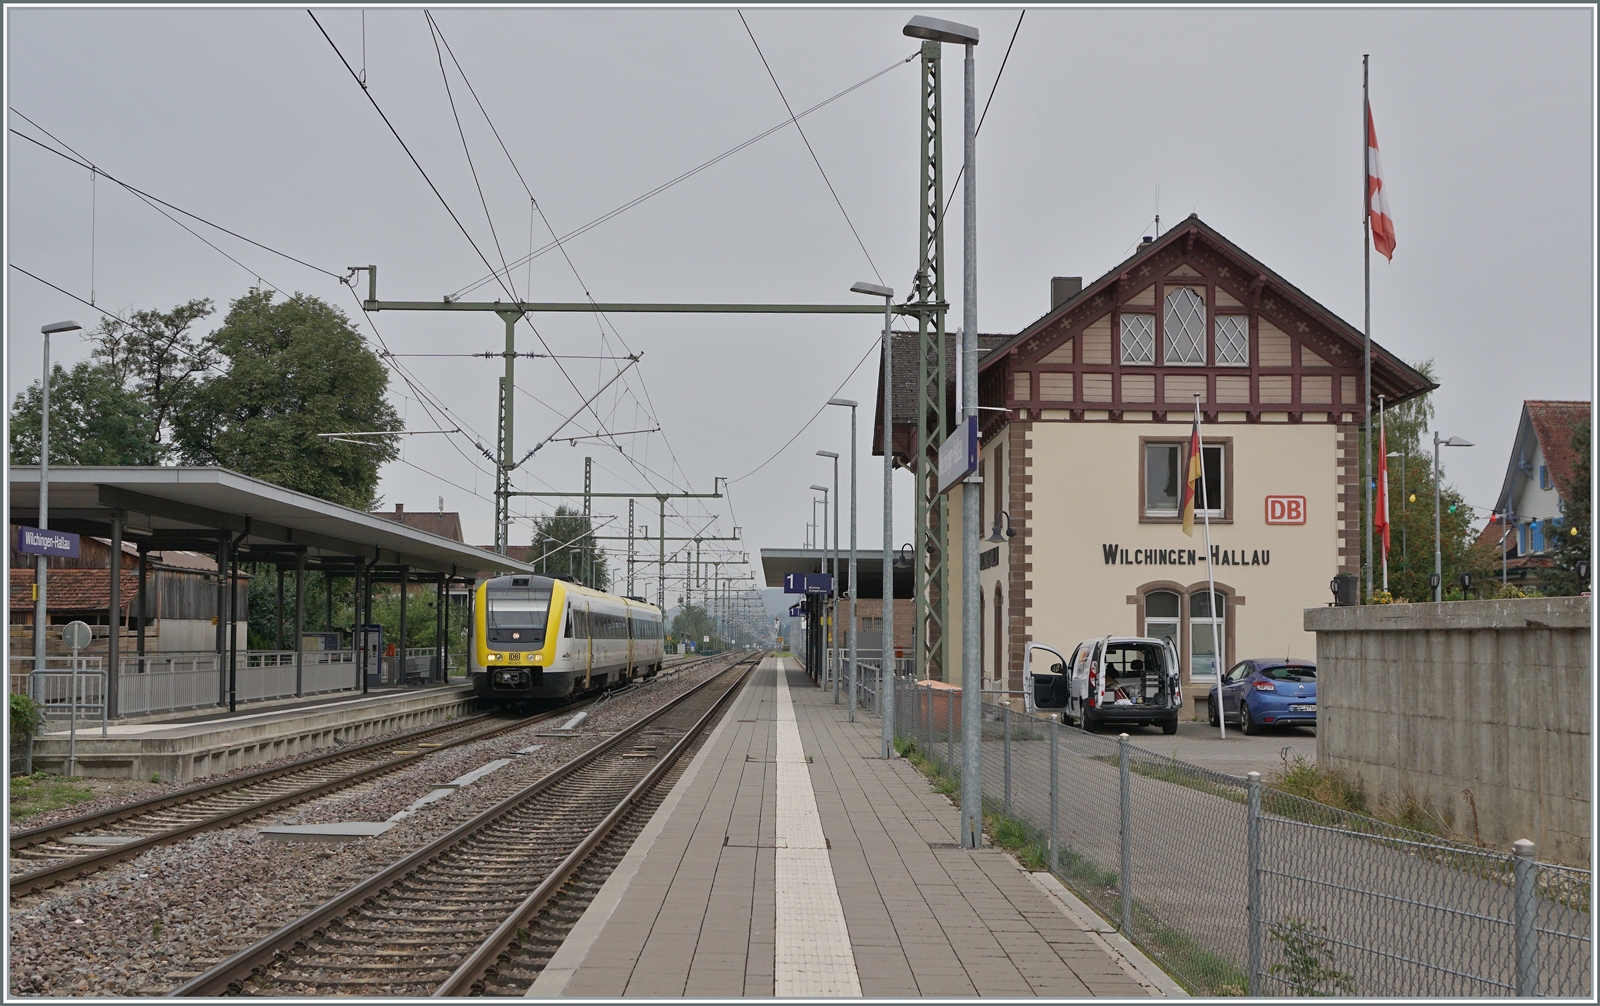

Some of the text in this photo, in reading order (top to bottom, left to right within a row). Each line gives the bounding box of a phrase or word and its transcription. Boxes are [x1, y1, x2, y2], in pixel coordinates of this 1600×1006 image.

[1270, 499, 1302, 520] DB
[25, 531, 71, 550] Wilchingen-Hallau
[786, 573, 794, 589] 1
